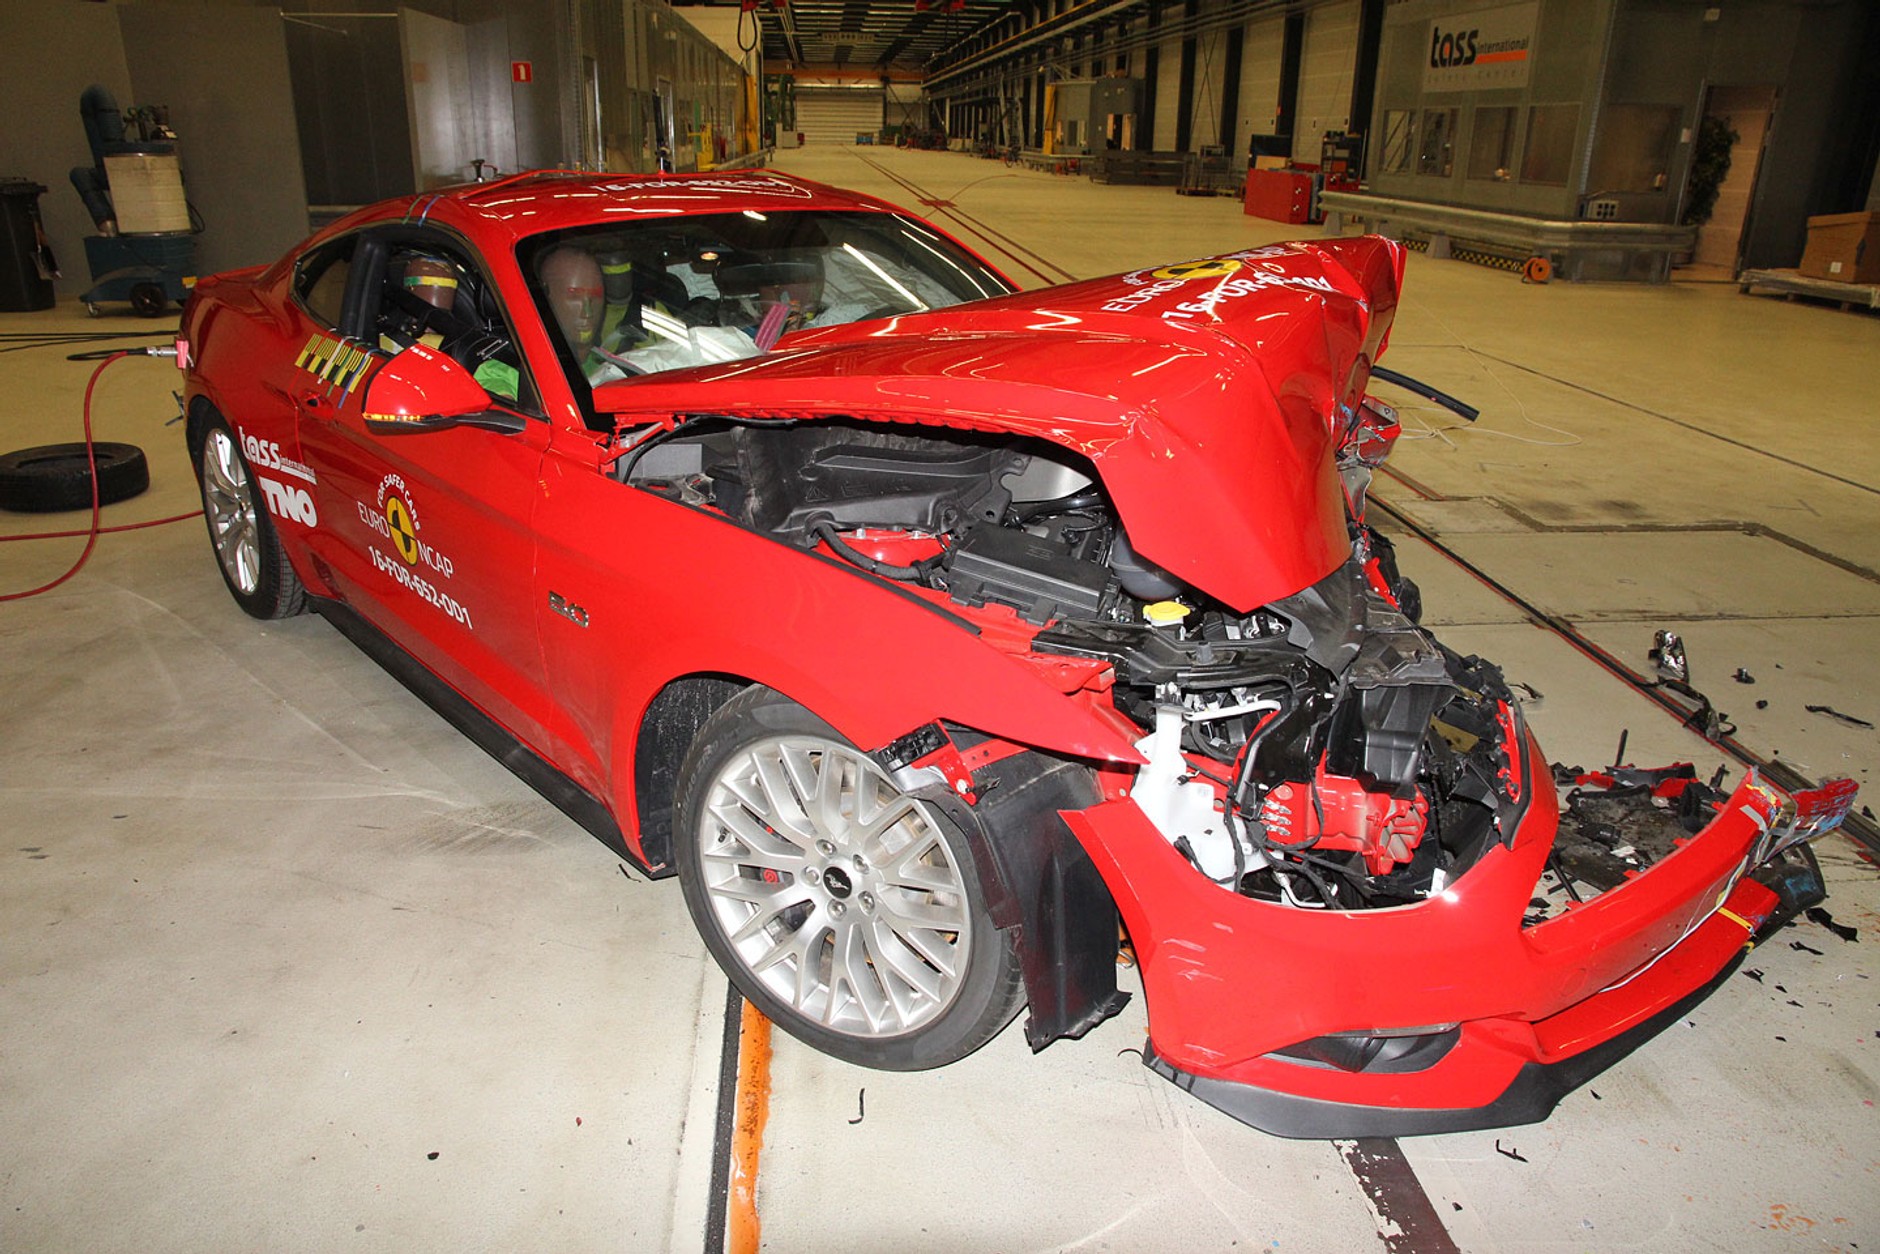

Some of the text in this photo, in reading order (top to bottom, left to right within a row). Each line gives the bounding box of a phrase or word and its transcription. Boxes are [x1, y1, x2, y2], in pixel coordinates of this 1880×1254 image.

[518, 64, 526, 80] 1
[1430, 26, 1479, 68] tass
[238, 425, 281, 470] tass
[259, 475, 318, 528] TNO
[384, 473, 405, 494] SAFER
[404, 490, 421, 531] CARS
[357, 501, 454, 579] EURO NCAP
[368, 545, 473, 630] 16-FOR-652-001
